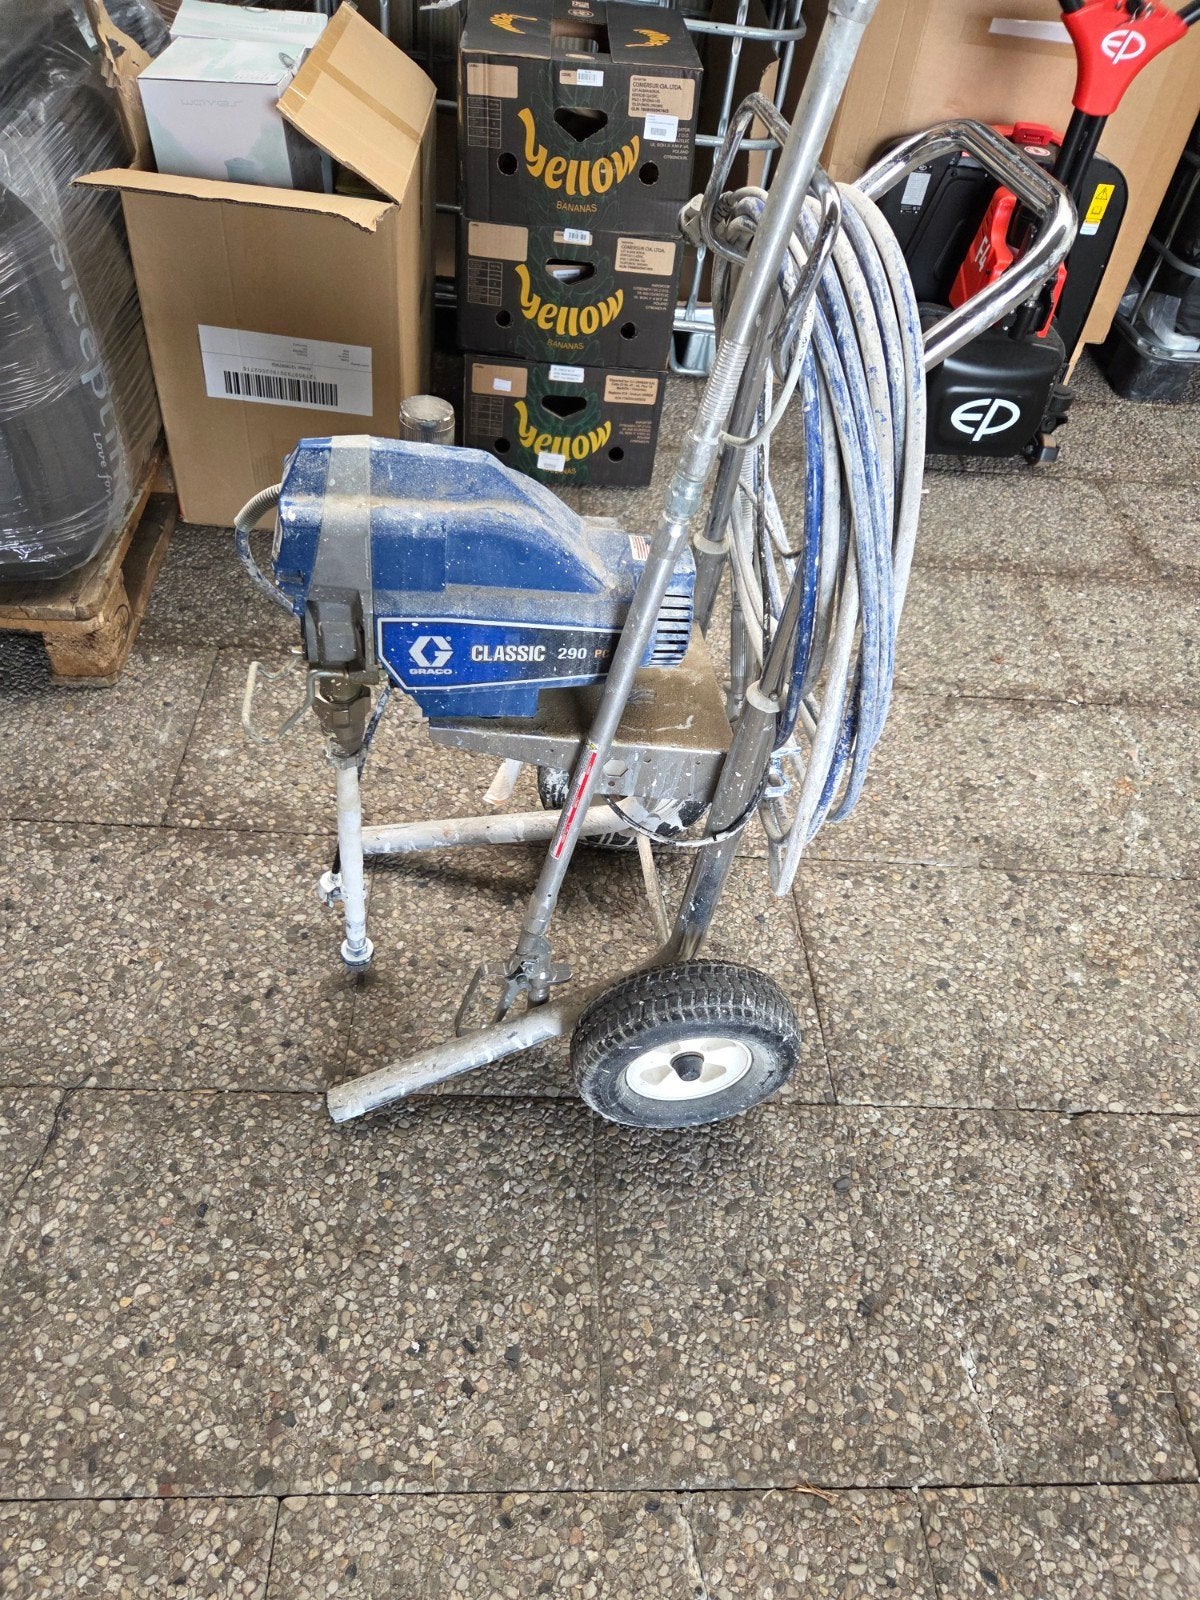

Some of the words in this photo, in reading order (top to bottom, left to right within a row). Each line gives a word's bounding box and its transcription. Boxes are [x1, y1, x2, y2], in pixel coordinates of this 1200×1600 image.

[517, 107, 640, 196] yellow
[556, 201, 598, 213] BANANAS
[514, 263, 624, 336] yellow
[547, 339, 585, 350] BANANAS
[950, 398, 1021, 442] EP
[471, 645, 546, 662] CLASSIC
[557, 647, 587, 660] 290
